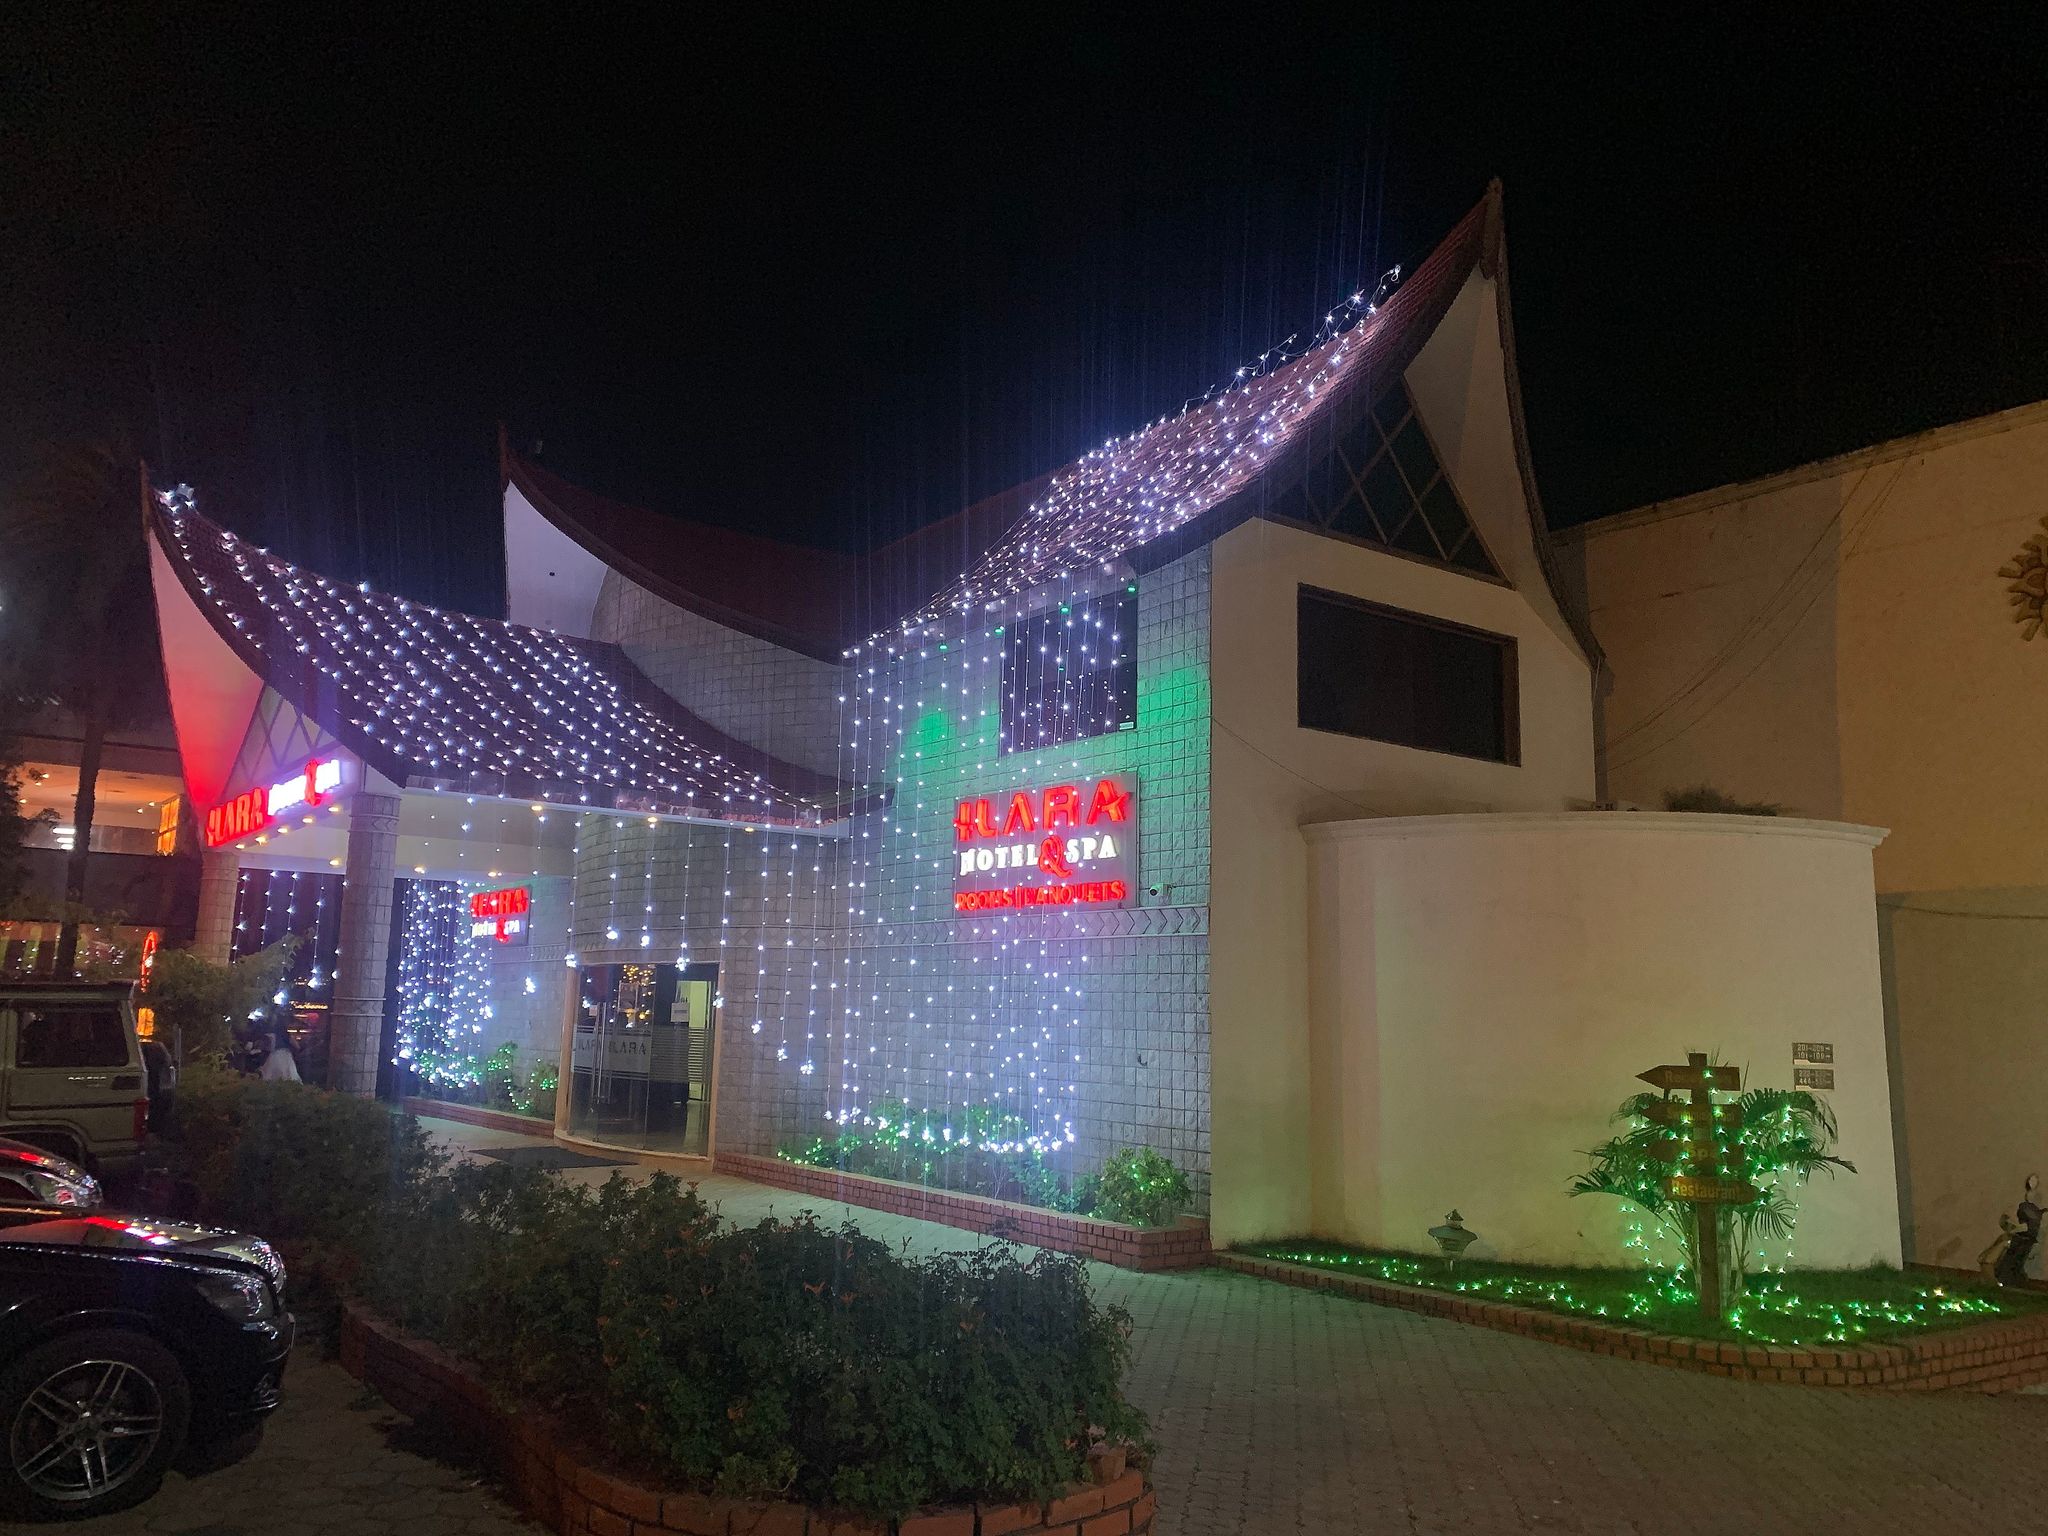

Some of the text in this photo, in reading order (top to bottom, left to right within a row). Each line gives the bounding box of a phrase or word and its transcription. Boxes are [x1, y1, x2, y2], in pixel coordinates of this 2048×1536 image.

[953, 780, 1130, 842] ILARA
[960, 834, 1117, 878] HOTEL & SPA
[955, 887, 1013, 910] ROOMS
[1671, 1179, 1740, 1198] Restaurant
